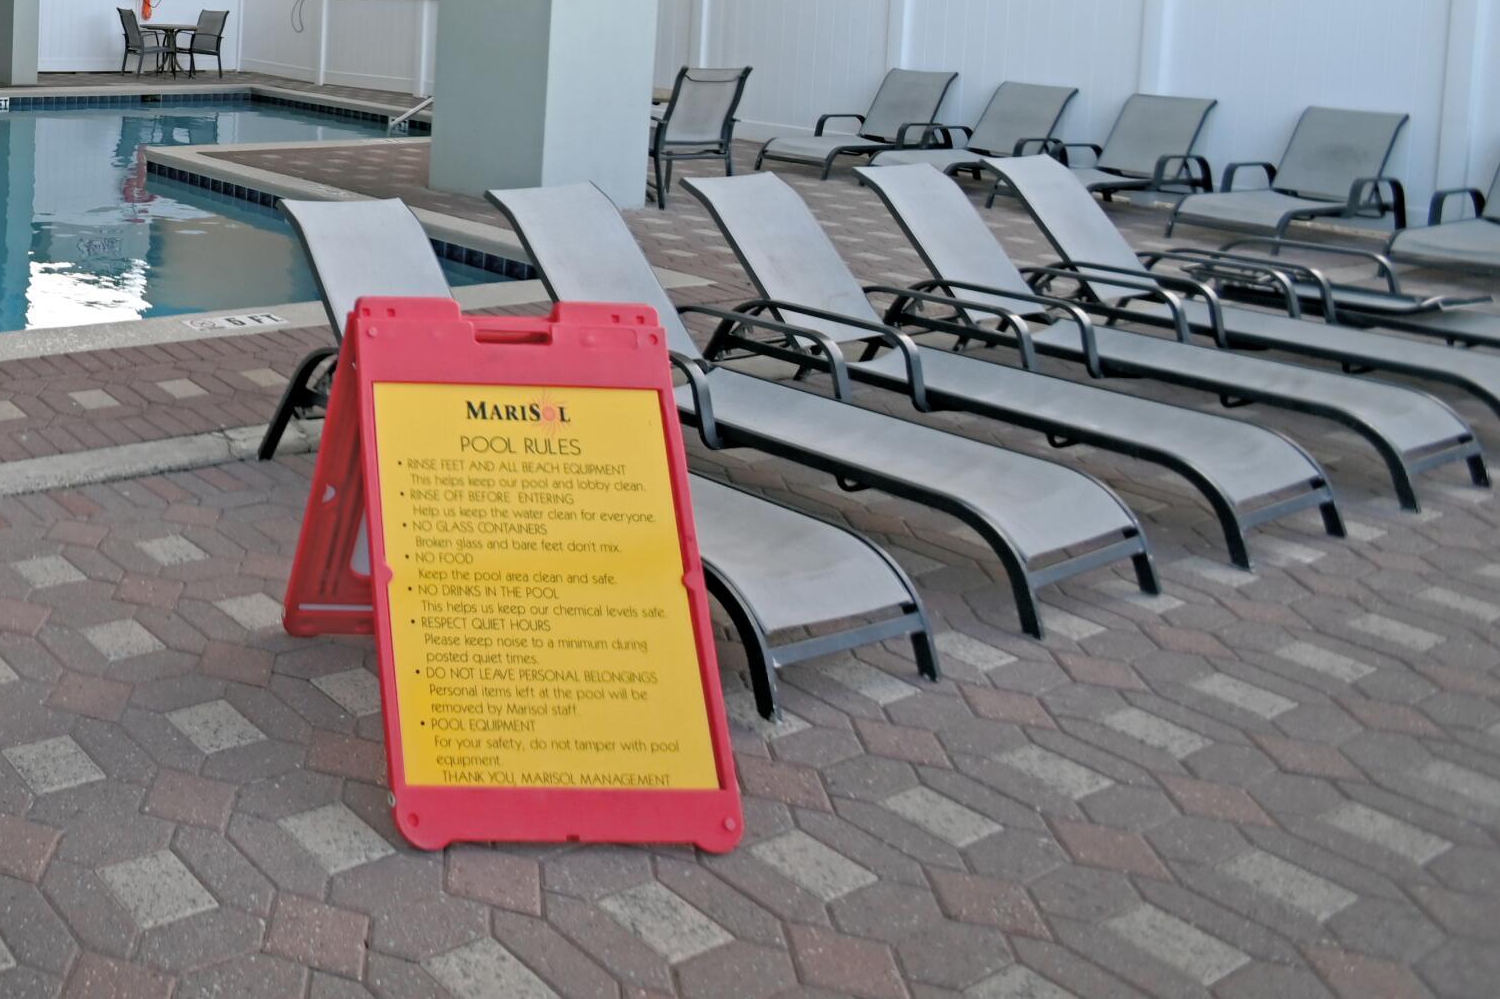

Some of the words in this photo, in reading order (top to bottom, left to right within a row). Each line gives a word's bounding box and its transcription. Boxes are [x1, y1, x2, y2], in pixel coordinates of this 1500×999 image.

[459, 435, 517, 454] POOL
[523, 437, 582, 456] RULES
[406, 457, 437, 471] RINSE
[440, 458, 465, 472] FEET
[468, 460, 496, 473] AND
[498, 460, 519, 474] ALL
[521, 461, 561, 475] BEACH
[562, 462, 626, 476] EQUIPMENT
[409, 472, 432, 486] This
[434, 474, 465, 489] helps
[467, 475, 496, 490] keep
[498, 477, 518, 489] our
[520, 477, 549, 491] pool
[551, 478, 574, 490] and
[576, 478, 611, 493] lobby
[409, 488, 440, 502] RINSE
[443, 489, 464, 502] OFF
[467, 489, 511, 504] BEFORE
[517, 491, 575, 506] ENTERING
[412, 504, 440, 519] Help
[442, 507, 457, 518] us
[458, 506, 488, 520] keep
[490, 506, 509, 519] the
[512, 508, 544, 520] water
[547, 508, 578, 521] clean
[580, 508, 596, 522] for
[412, 519, 433, 533] NO
[435, 520, 475, 534] GLASS
[477, 520, 548, 536] CONTAINERS
[415, 535, 453, 549] Broken
[455, 537, 484, 552] glass
[486, 538, 509, 550] and
[511, 538, 538, 551] bare
[540, 538, 563, 552] feet
[566, 540, 597, 553] don't
[414, 551, 436, 564] NO
[438, 551, 474, 565] FOOD
[418, 567, 448, 582] Keep
[451, 569, 470, 581] the
[473, 569, 502, 583] pool
[505, 572, 530, 583] area
[532, 571, 564, 584] clean
[566, 572, 589, 584] and
[417, 583, 439, 596] NO
[441, 584, 482, 598] DRINKS
[484, 585, 497, 597] IN
[499, 585, 522, 599] THE
[525, 586, 560, 600] POOL
[421, 599, 443, 613] This
[446, 601, 478, 616] helps
[480, 603, 495, 615] us
[497, 602, 527, 617] keep
[529, 605, 550, 616] our
[552, 603, 603, 617] chemical
[605, 605, 639, 619] levels
[420, 615, 467, 630] RESPECT
[471, 616, 506, 631] QUIET
[509, 618, 552, 632] HOURS
[424, 632, 461, 647] Please
[464, 633, 493, 649] keep
[496, 637, 528, 649] noise
[531, 636, 544, 649] to
[547, 638, 555, 649] a
[557, 639, 609, 650] minimum
[611, 638, 649, 654] during
[426, 650, 469, 664] posted
[471, 652, 503, 666] quiet
[425, 666, 447, 680] DO
[449, 666, 476, 680] NOT
[478, 667, 516, 681] LEAVE
[518, 668, 580, 683] PERSONAL
[583, 669, 659, 684] BELONGINGS
[429, 683, 478, 698] Personal
[481, 685, 512, 699] items
[515, 685, 535, 699] left
[538, 687, 550, 699] at
[552, 686, 573, 699] the
[575, 687, 605, 702] pool
[607, 688, 629, 700] will
[630, 688, 648, 701] be
[430, 701, 484, 715] removed
[486, 701, 503, 717] by
[506, 702, 548, 715] Marisol
[430, 717, 466, 732] POOL
[468, 718, 535, 732] EQUIPMENT
[434, 735, 452, 748] For
[455, 737, 482, 751] your
[485, 736, 525, 752] safety,
[529, 737, 548, 751] do
[550, 738, 571, 751] not
[574, 739, 616, 754] tamper
[619, 739, 647, 753] with
[649, 739, 680, 754] pool
[442, 769, 485, 784] THANK
[521, 771, 576, 785] MARISOL
[579, 773, 670, 787] MANAGEMENT
